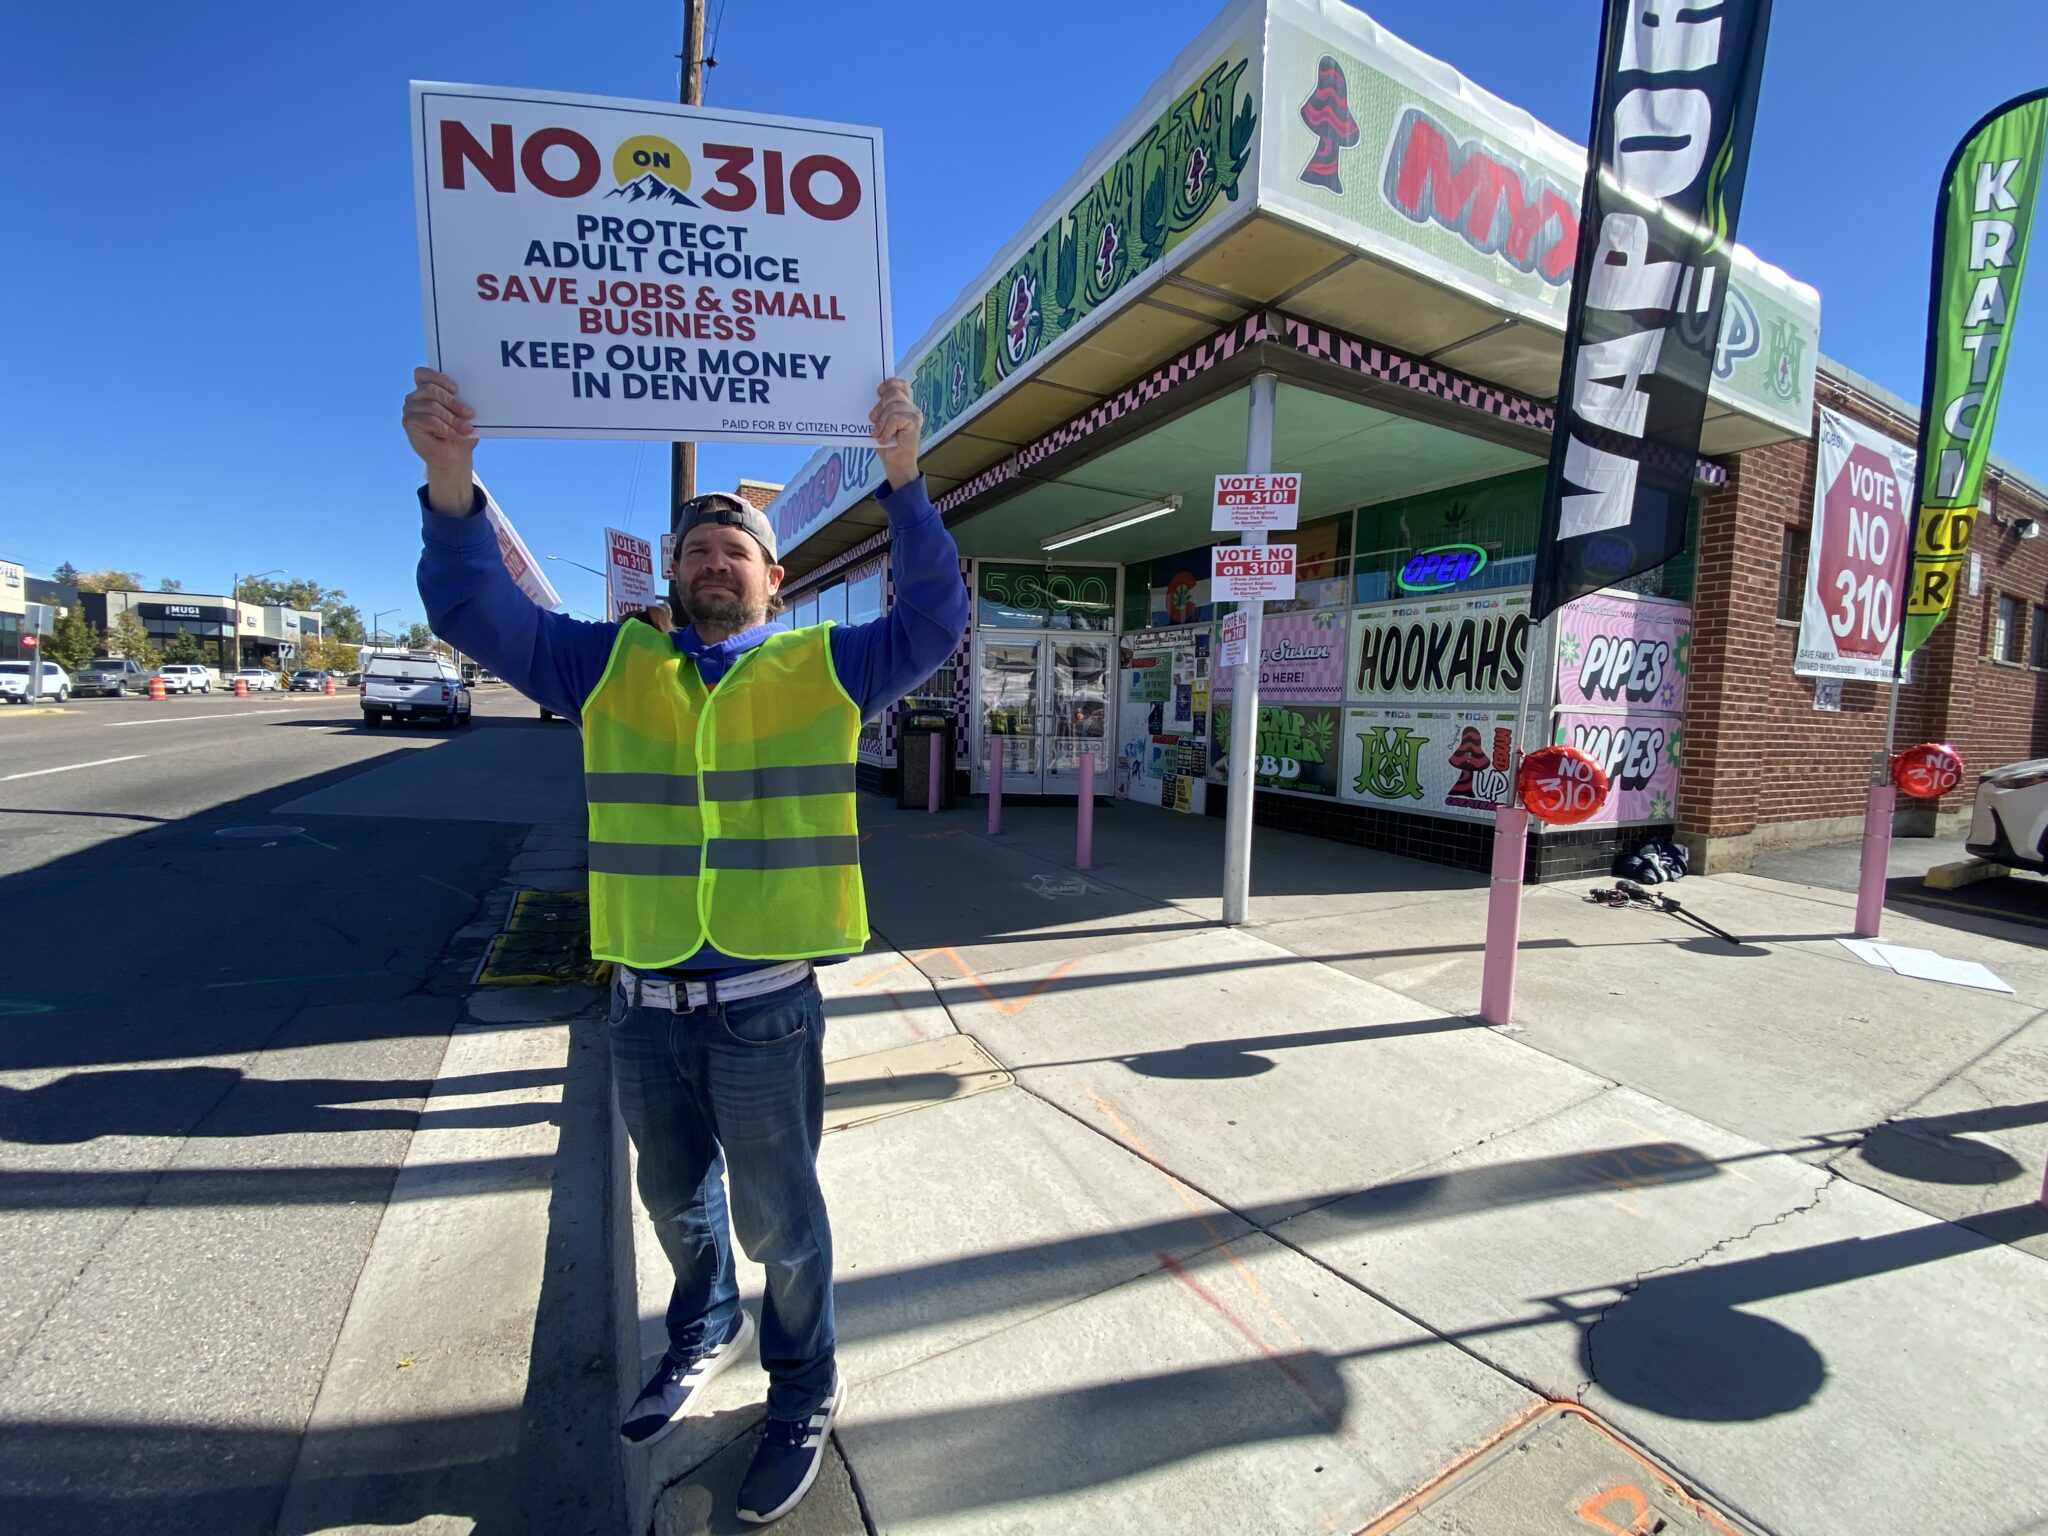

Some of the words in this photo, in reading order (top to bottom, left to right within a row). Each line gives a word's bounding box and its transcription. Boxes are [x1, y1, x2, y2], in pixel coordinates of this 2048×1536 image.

[440, 120, 601, 198] NO
[633, 150, 671, 169] ON
[701, 142, 862, 221] 310
[577, 214, 748, 251] PROTECT
[523, 240, 649, 273] ADULT
[658, 249, 800, 283] CHOICE
[477, 273, 579, 305] SAVE
[587, 279, 686, 309] JOBS
[695, 286, 723, 313] &
[732, 288, 846, 321] SMALL
[579, 307, 756, 342] BUSINESS
[501, 340, 595, 369] KEEP
[606, 344, 687, 373] OUR
[698, 348, 831, 380] MONEY
[572, 371, 611, 398] IN
[622, 373, 770, 404] DENVER
[722, 419, 749, 430] PAID
[752, 420, 775, 431] FOR
[778, 421, 793, 431] BY
[796, 422, 838, 433] CITIZEN
[1219, 478, 1266, 490] VOTE
[1271, 477, 1298, 489] NO
[1225, 494, 1246, 504] on
[1252, 490, 1289, 503] 310!
[1848, 461, 1895, 511] VOTE
[611, 532, 636, 553] VOTE
[638, 542, 651, 558] NO
[1847, 507, 1889, 566] NO
[617, 554, 629, 566] on
[631, 555, 649, 573] 310!
[1216, 549, 1262, 561] VOTE
[1268, 548, 1293, 560] NO
[1223, 566, 1244, 575] on
[1249, 562, 1286, 575] 310!
[1402, 553, 1477, 583] OPEN
[985, 572, 1108, 613] 5800
[1831, 569, 1893, 643] 310
[1270, 639, 1329, 662] Susan
[1357, 613, 1530, 692] HOOKAHS
[1800, 649, 1815, 660] SAVE
[1272, 672, 1304, 683] HERE!
[1578, 635, 1669, 701] PIPES
[1258, 707, 1305, 735] EMP
[1256, 755, 1301, 779] BD
[1558, 757, 1593, 782] NO
[1574, 724, 1664, 790] VAPES
[1926, 754, 1956, 772] NO
[1477, 769, 1508, 803] UP
[1907, 768, 1957, 790] 310
[1536, 778, 1596, 812] 310
